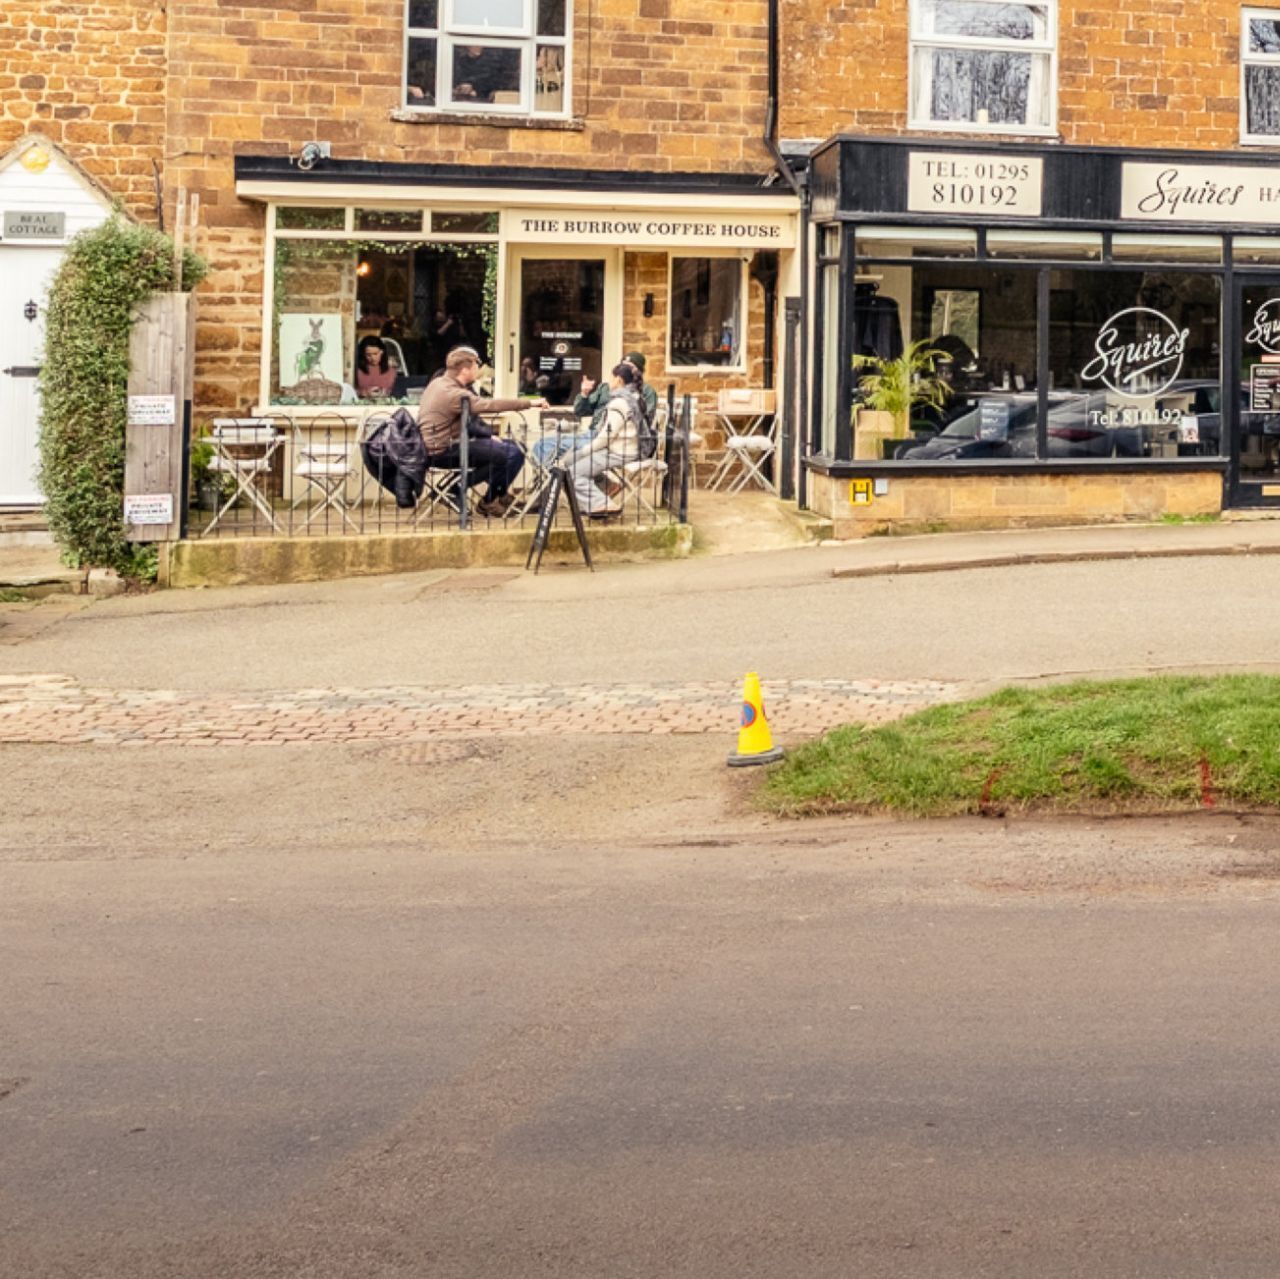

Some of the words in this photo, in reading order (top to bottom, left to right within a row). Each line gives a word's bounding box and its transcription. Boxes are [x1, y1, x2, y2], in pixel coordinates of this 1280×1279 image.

[922, 161, 968, 178] TEL:
[975, 163, 1029, 181] 01295
[932, 182, 1017, 205] 810192
[1138, 168, 1244, 215] Squires
[521, 219, 559, 232] THE
[564, 220, 641, 234] BURROW
[646, 222, 716, 236] COFFEE
[721, 224, 781, 238] HOUSE
[1081, 328, 1190, 380] Squires
[1123, 408, 1182, 425] 810192
